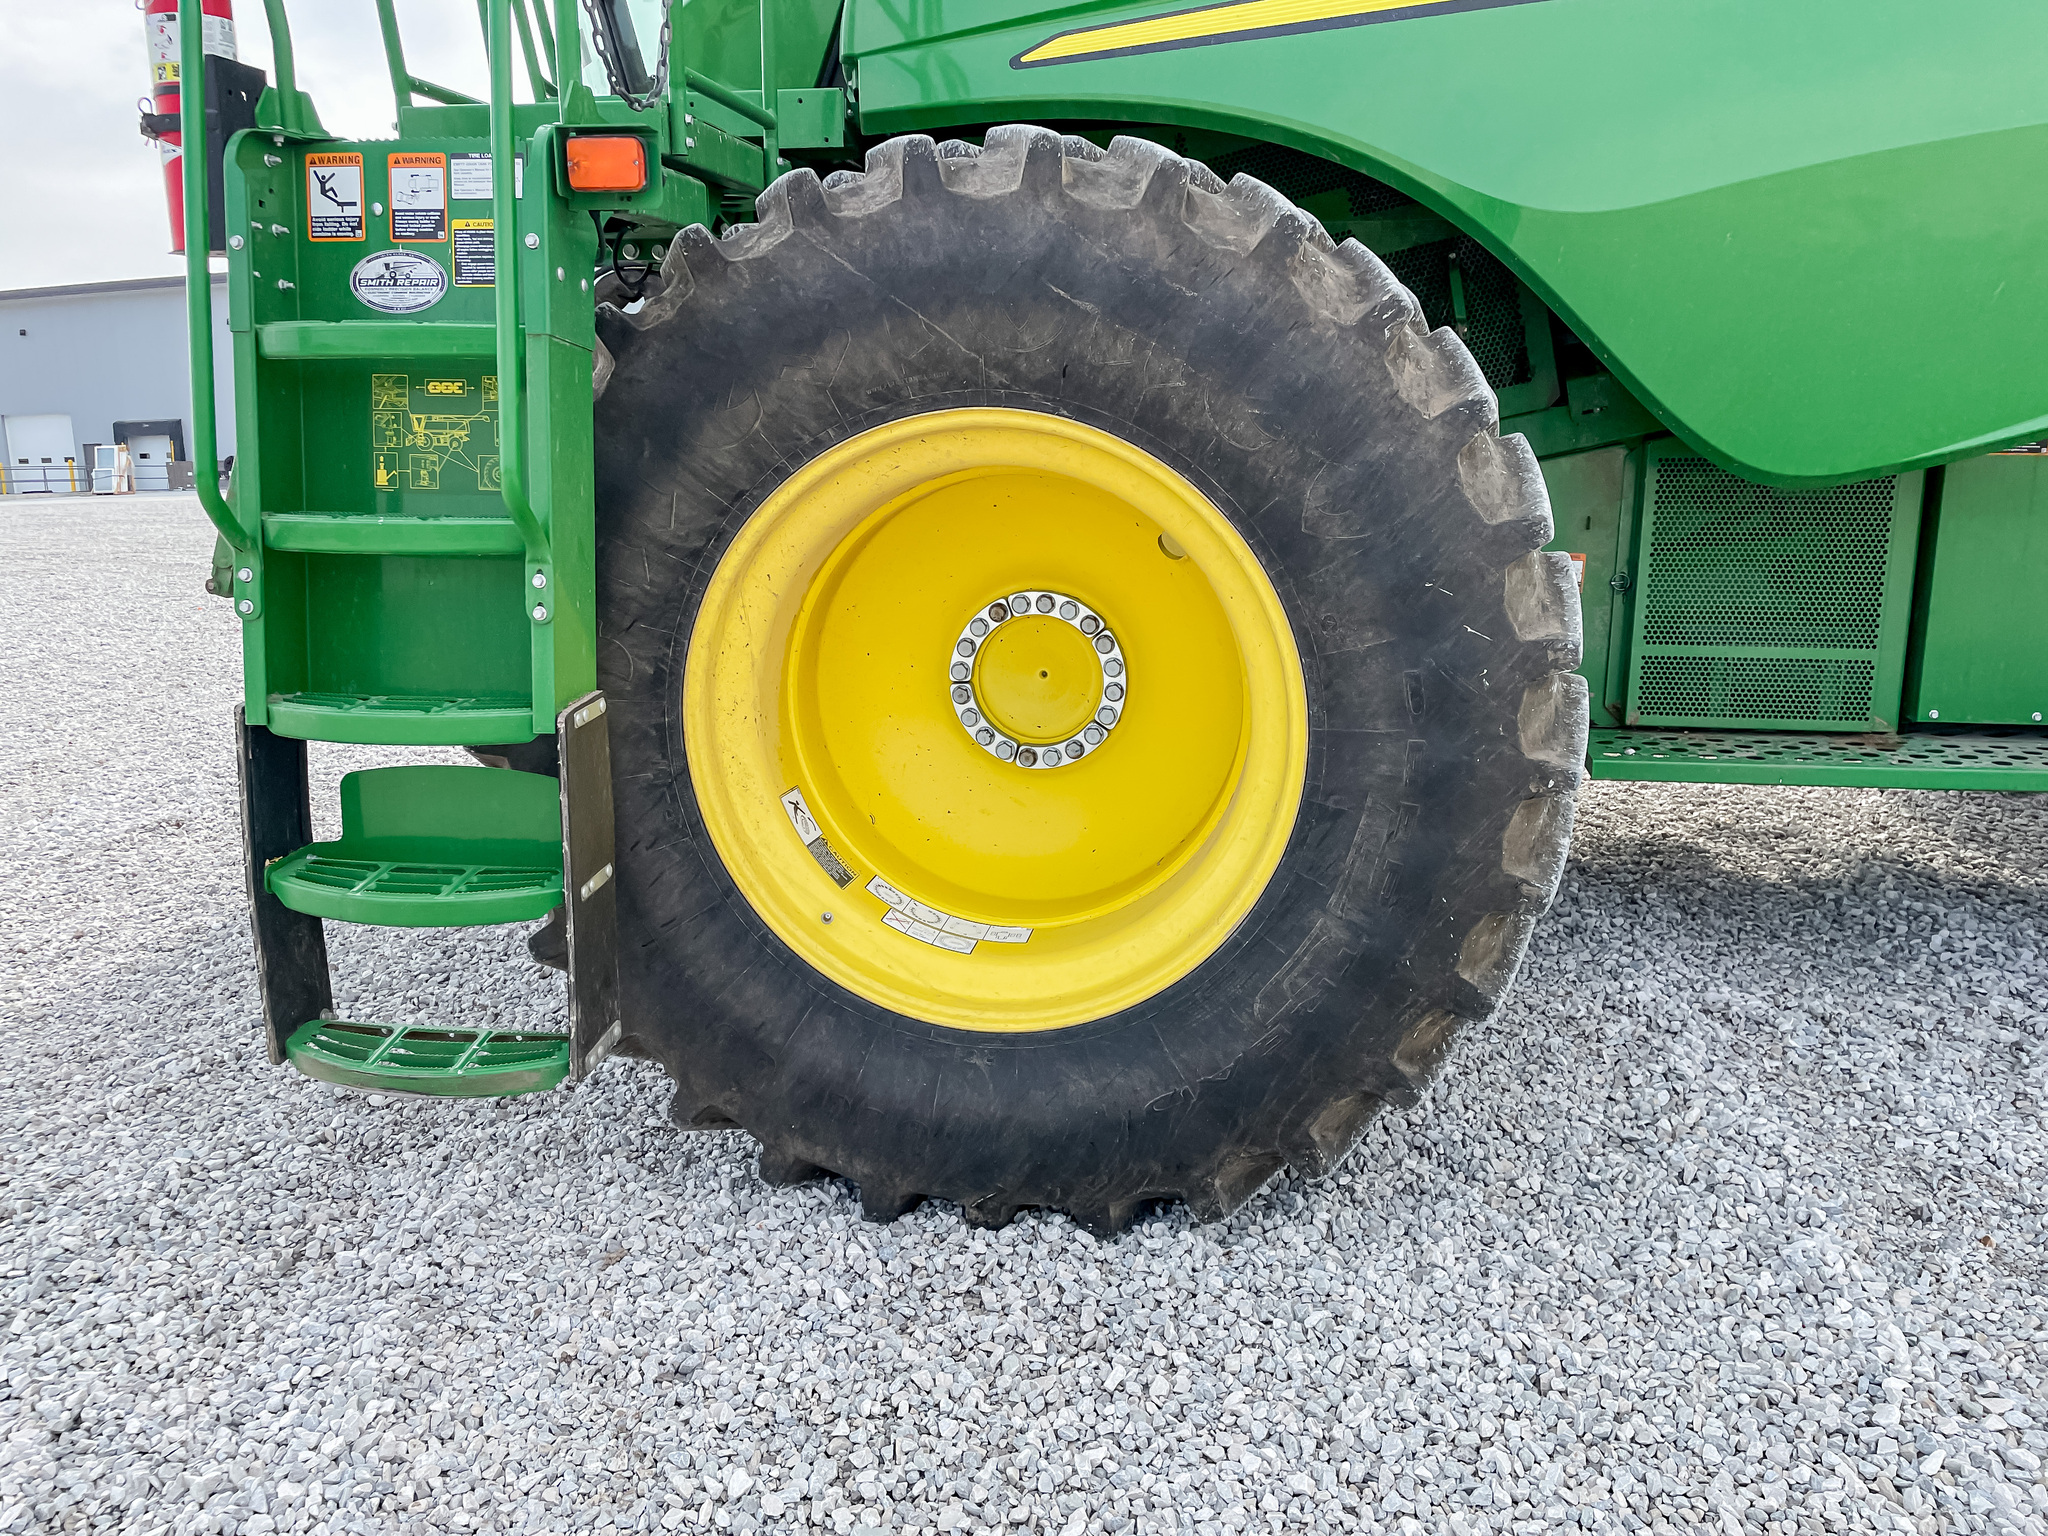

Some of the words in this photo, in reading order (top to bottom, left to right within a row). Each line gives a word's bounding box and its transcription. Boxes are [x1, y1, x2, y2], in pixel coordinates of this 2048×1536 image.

[317, 155, 360, 165] WARNING
[401, 156, 442, 164] WARNING
[359, 278, 394, 286] SMITH
[396, 278, 439, 286] REPAIR
[828, 845, 857, 876] CAUTION
